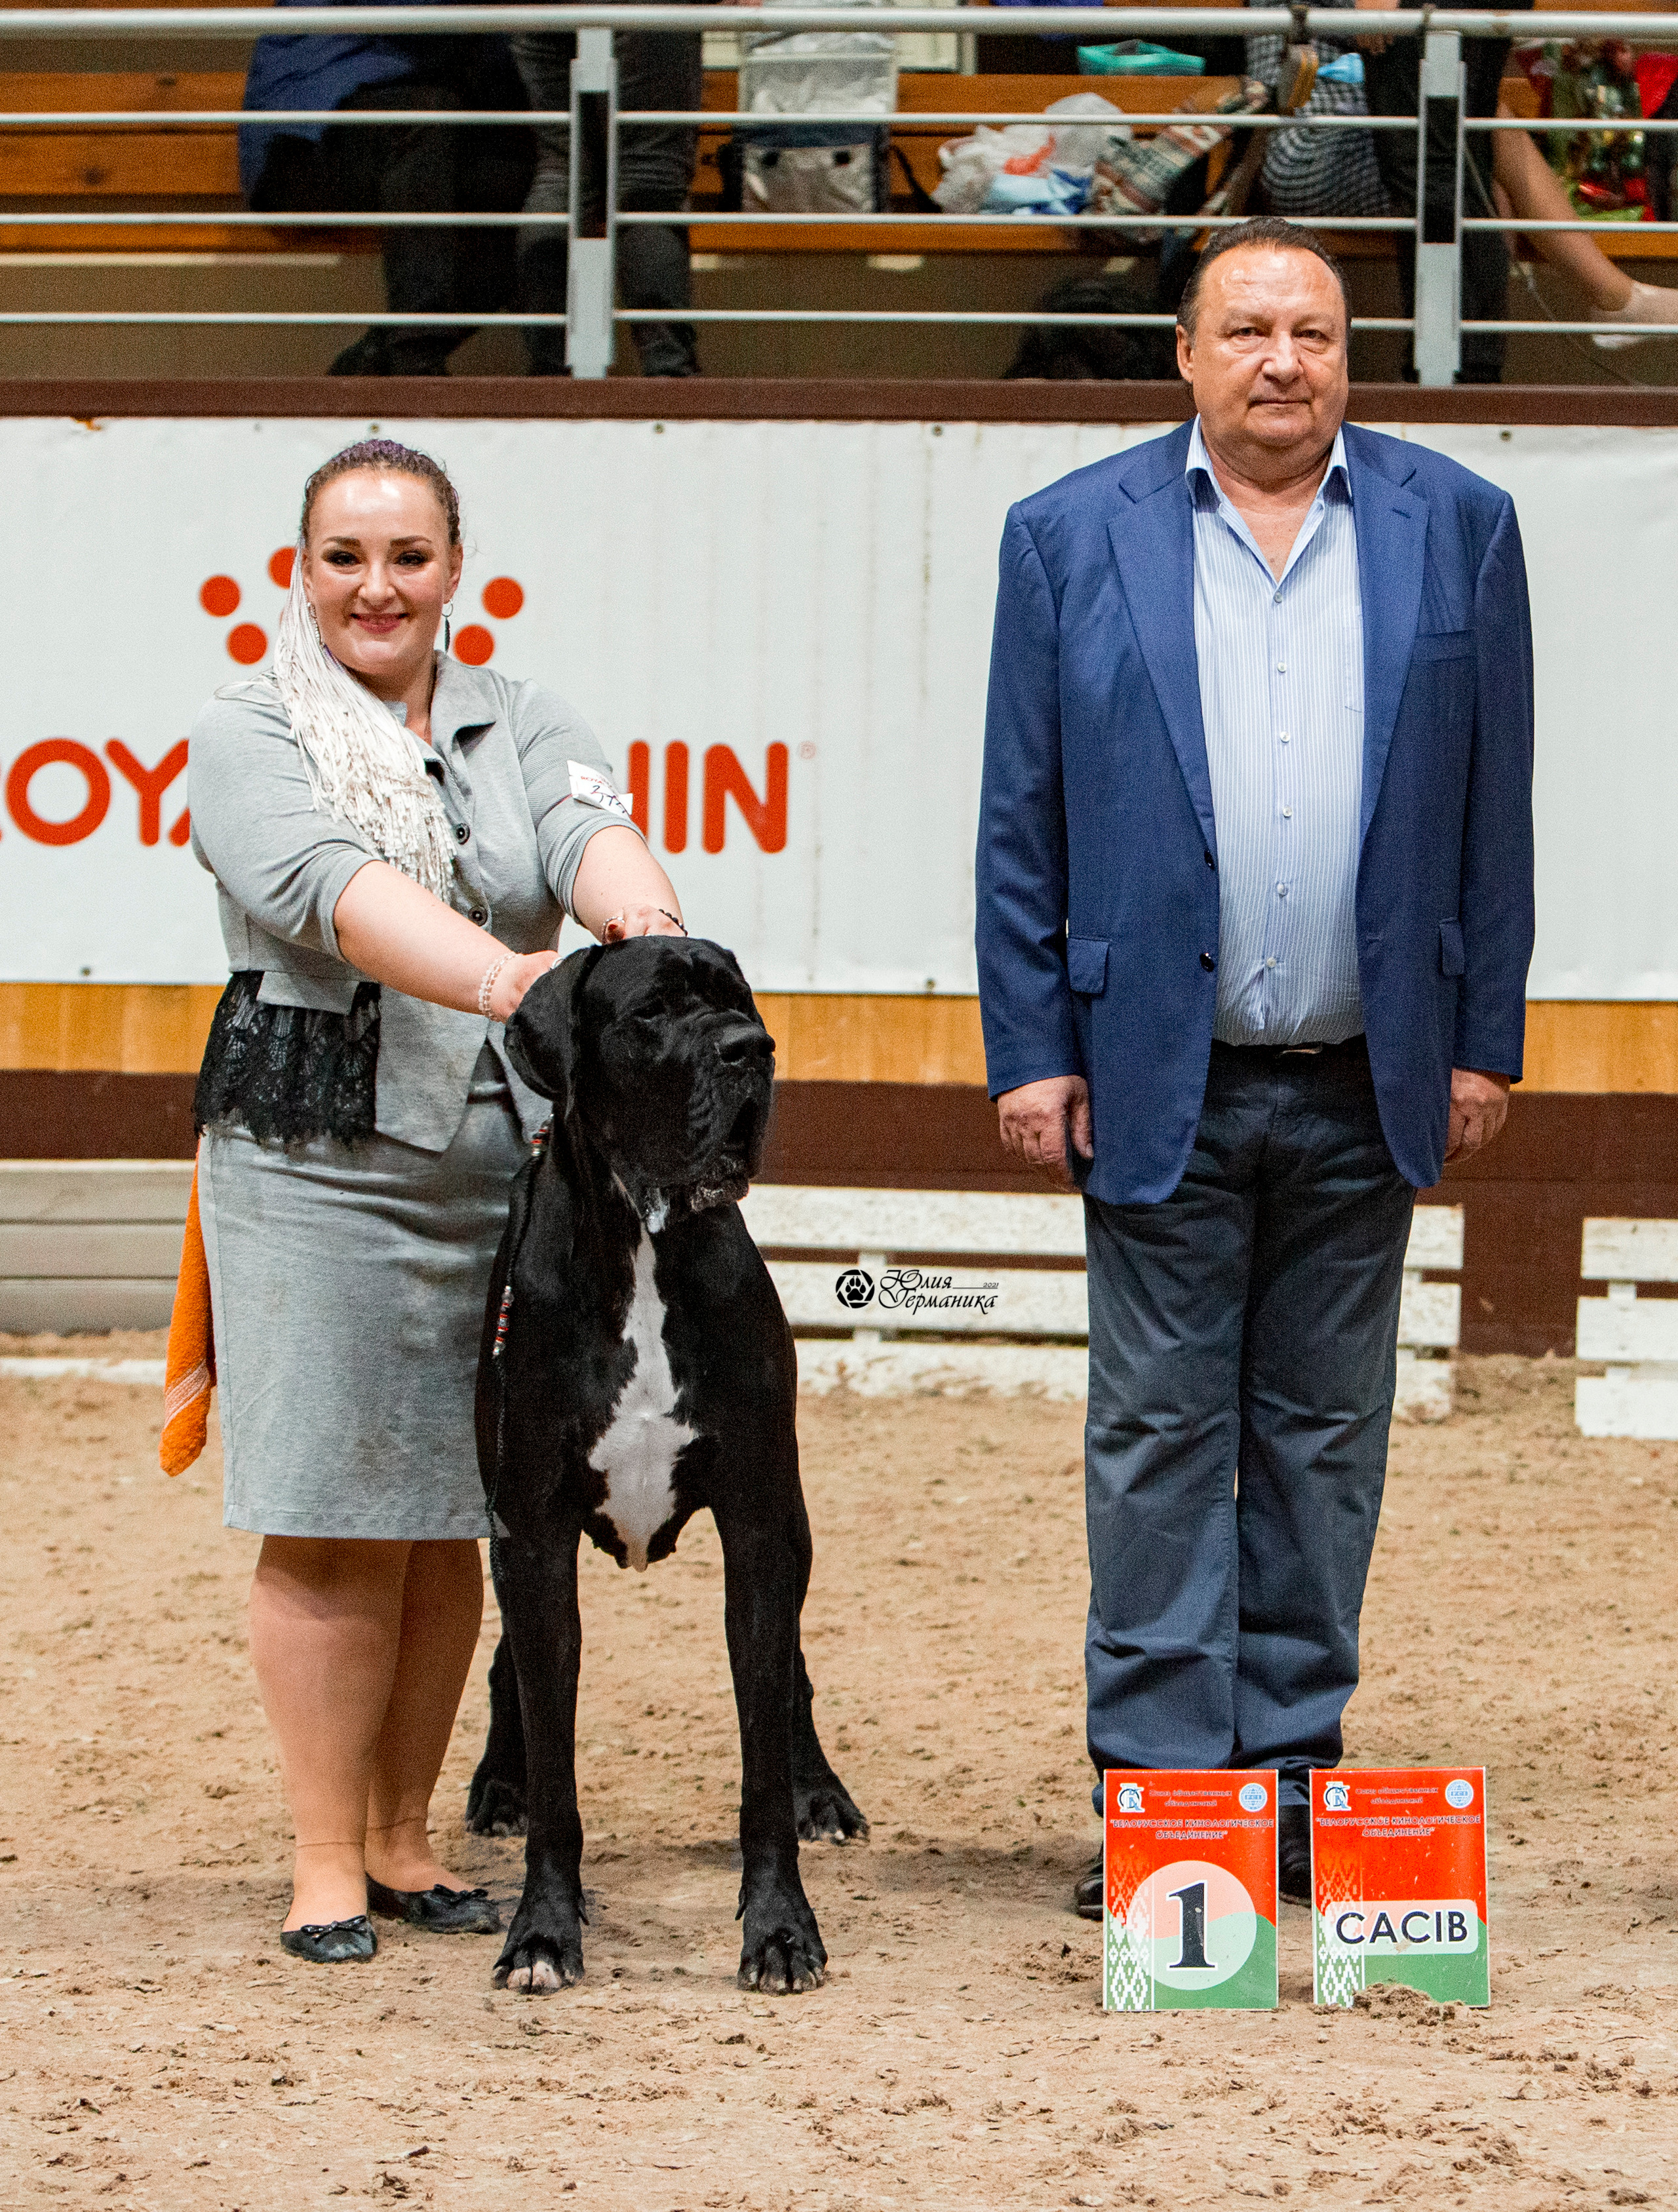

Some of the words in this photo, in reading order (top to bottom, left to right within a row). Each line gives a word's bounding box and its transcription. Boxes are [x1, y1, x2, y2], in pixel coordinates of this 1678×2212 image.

[0, 737, 190, 847] OY
[1184, 1819, 1274, 1828] КИНОЛОГИЧЕСКОЕ
[1391, 1815, 1481, 1825] КИНОЛОГИЧЕСКОЕ
[1167, 1881, 1217, 1969] 1
[1335, 1911, 1468, 1945] CACIB
